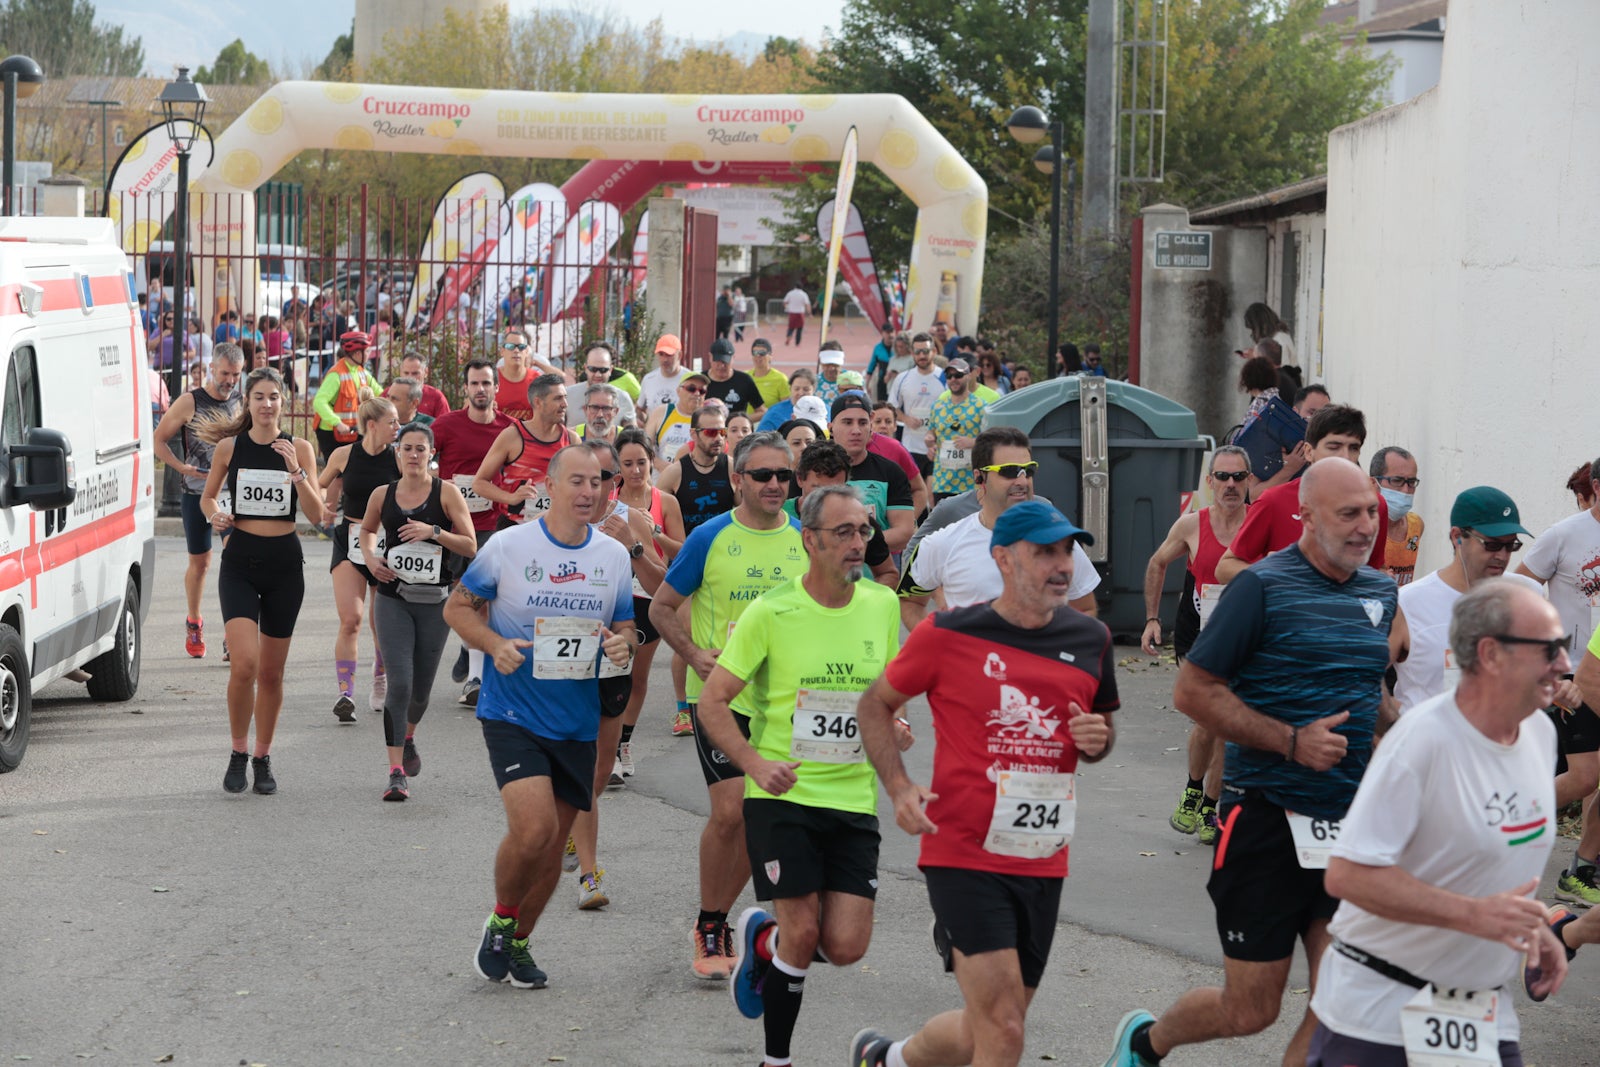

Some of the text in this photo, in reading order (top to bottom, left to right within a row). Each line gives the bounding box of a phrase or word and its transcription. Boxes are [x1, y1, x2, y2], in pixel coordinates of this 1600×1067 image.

[363, 96, 471, 119] Cruzcampo
[697, 105, 805, 125] Cruzcampo
[497, 109, 519, 123] CON
[523, 109, 555, 124] ZUMO
[558, 110, 610, 124] NATURAL
[613, 111, 627, 125] DE
[373, 119, 424, 138] Radler
[496, 124, 668, 143] DOBLEMENTE REFRESCANTE
[707, 128, 760, 146] Radler
[928, 234, 977, 249] Cruzcampo
[1174, 235, 1205, 245] CALLE
[946, 449, 965, 460] 788
[243, 486, 284, 503] 3043
[394, 555, 434, 573] 3094
[557, 560, 578, 577] 35
[526, 595, 603, 611] MARACENA
[557, 639, 582, 658] 27
[826, 663, 854, 675] XXV
[800, 677, 876, 686] PRUEBA DE FOND
[812, 714, 857, 739] 346
[1013, 803, 1061, 829] 234
[1425, 1017, 1478, 1052] 309
